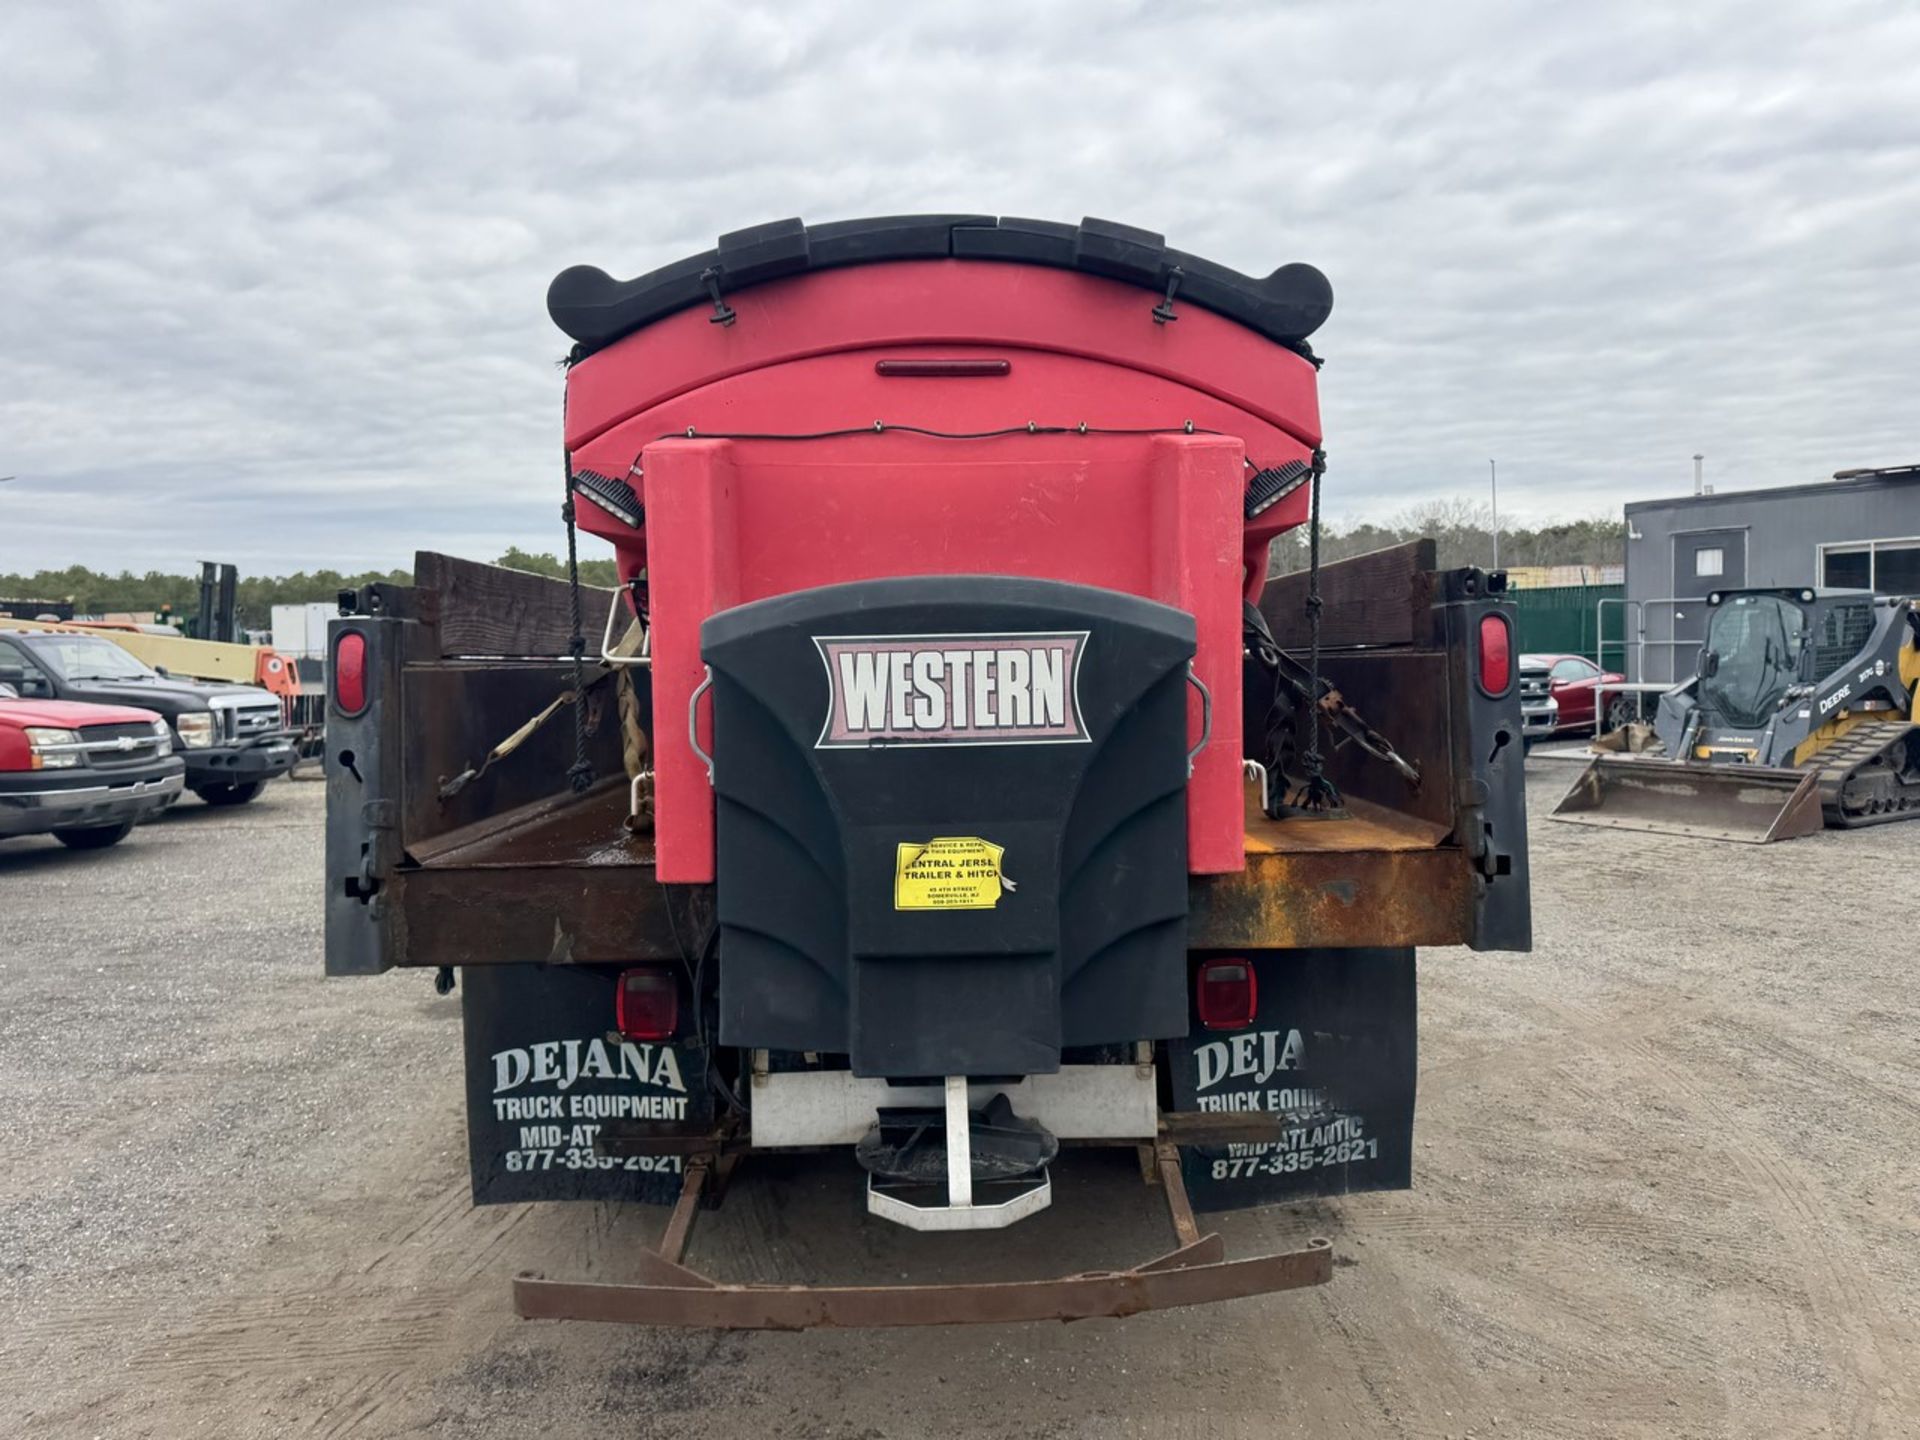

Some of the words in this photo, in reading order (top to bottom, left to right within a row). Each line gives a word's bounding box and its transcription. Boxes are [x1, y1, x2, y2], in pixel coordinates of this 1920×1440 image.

[838, 649, 1065, 731] WESTERN
[1819, 684, 1851, 714] DEERE
[905, 871, 951, 880] TRAILER
[955, 870, 963, 878] &
[491, 1038, 687, 1093] DEJANA
[1193, 1029, 1307, 1091] DEJA
[493, 1096, 564, 1120] TRUCK
[570, 1095, 688, 1120] EQUIPMENT
[1197, 1091, 1260, 1112] TRUCK
[520, 1124, 601, 1148] MID-AT
[1211, 1138, 1378, 1180] 877-335-2621
